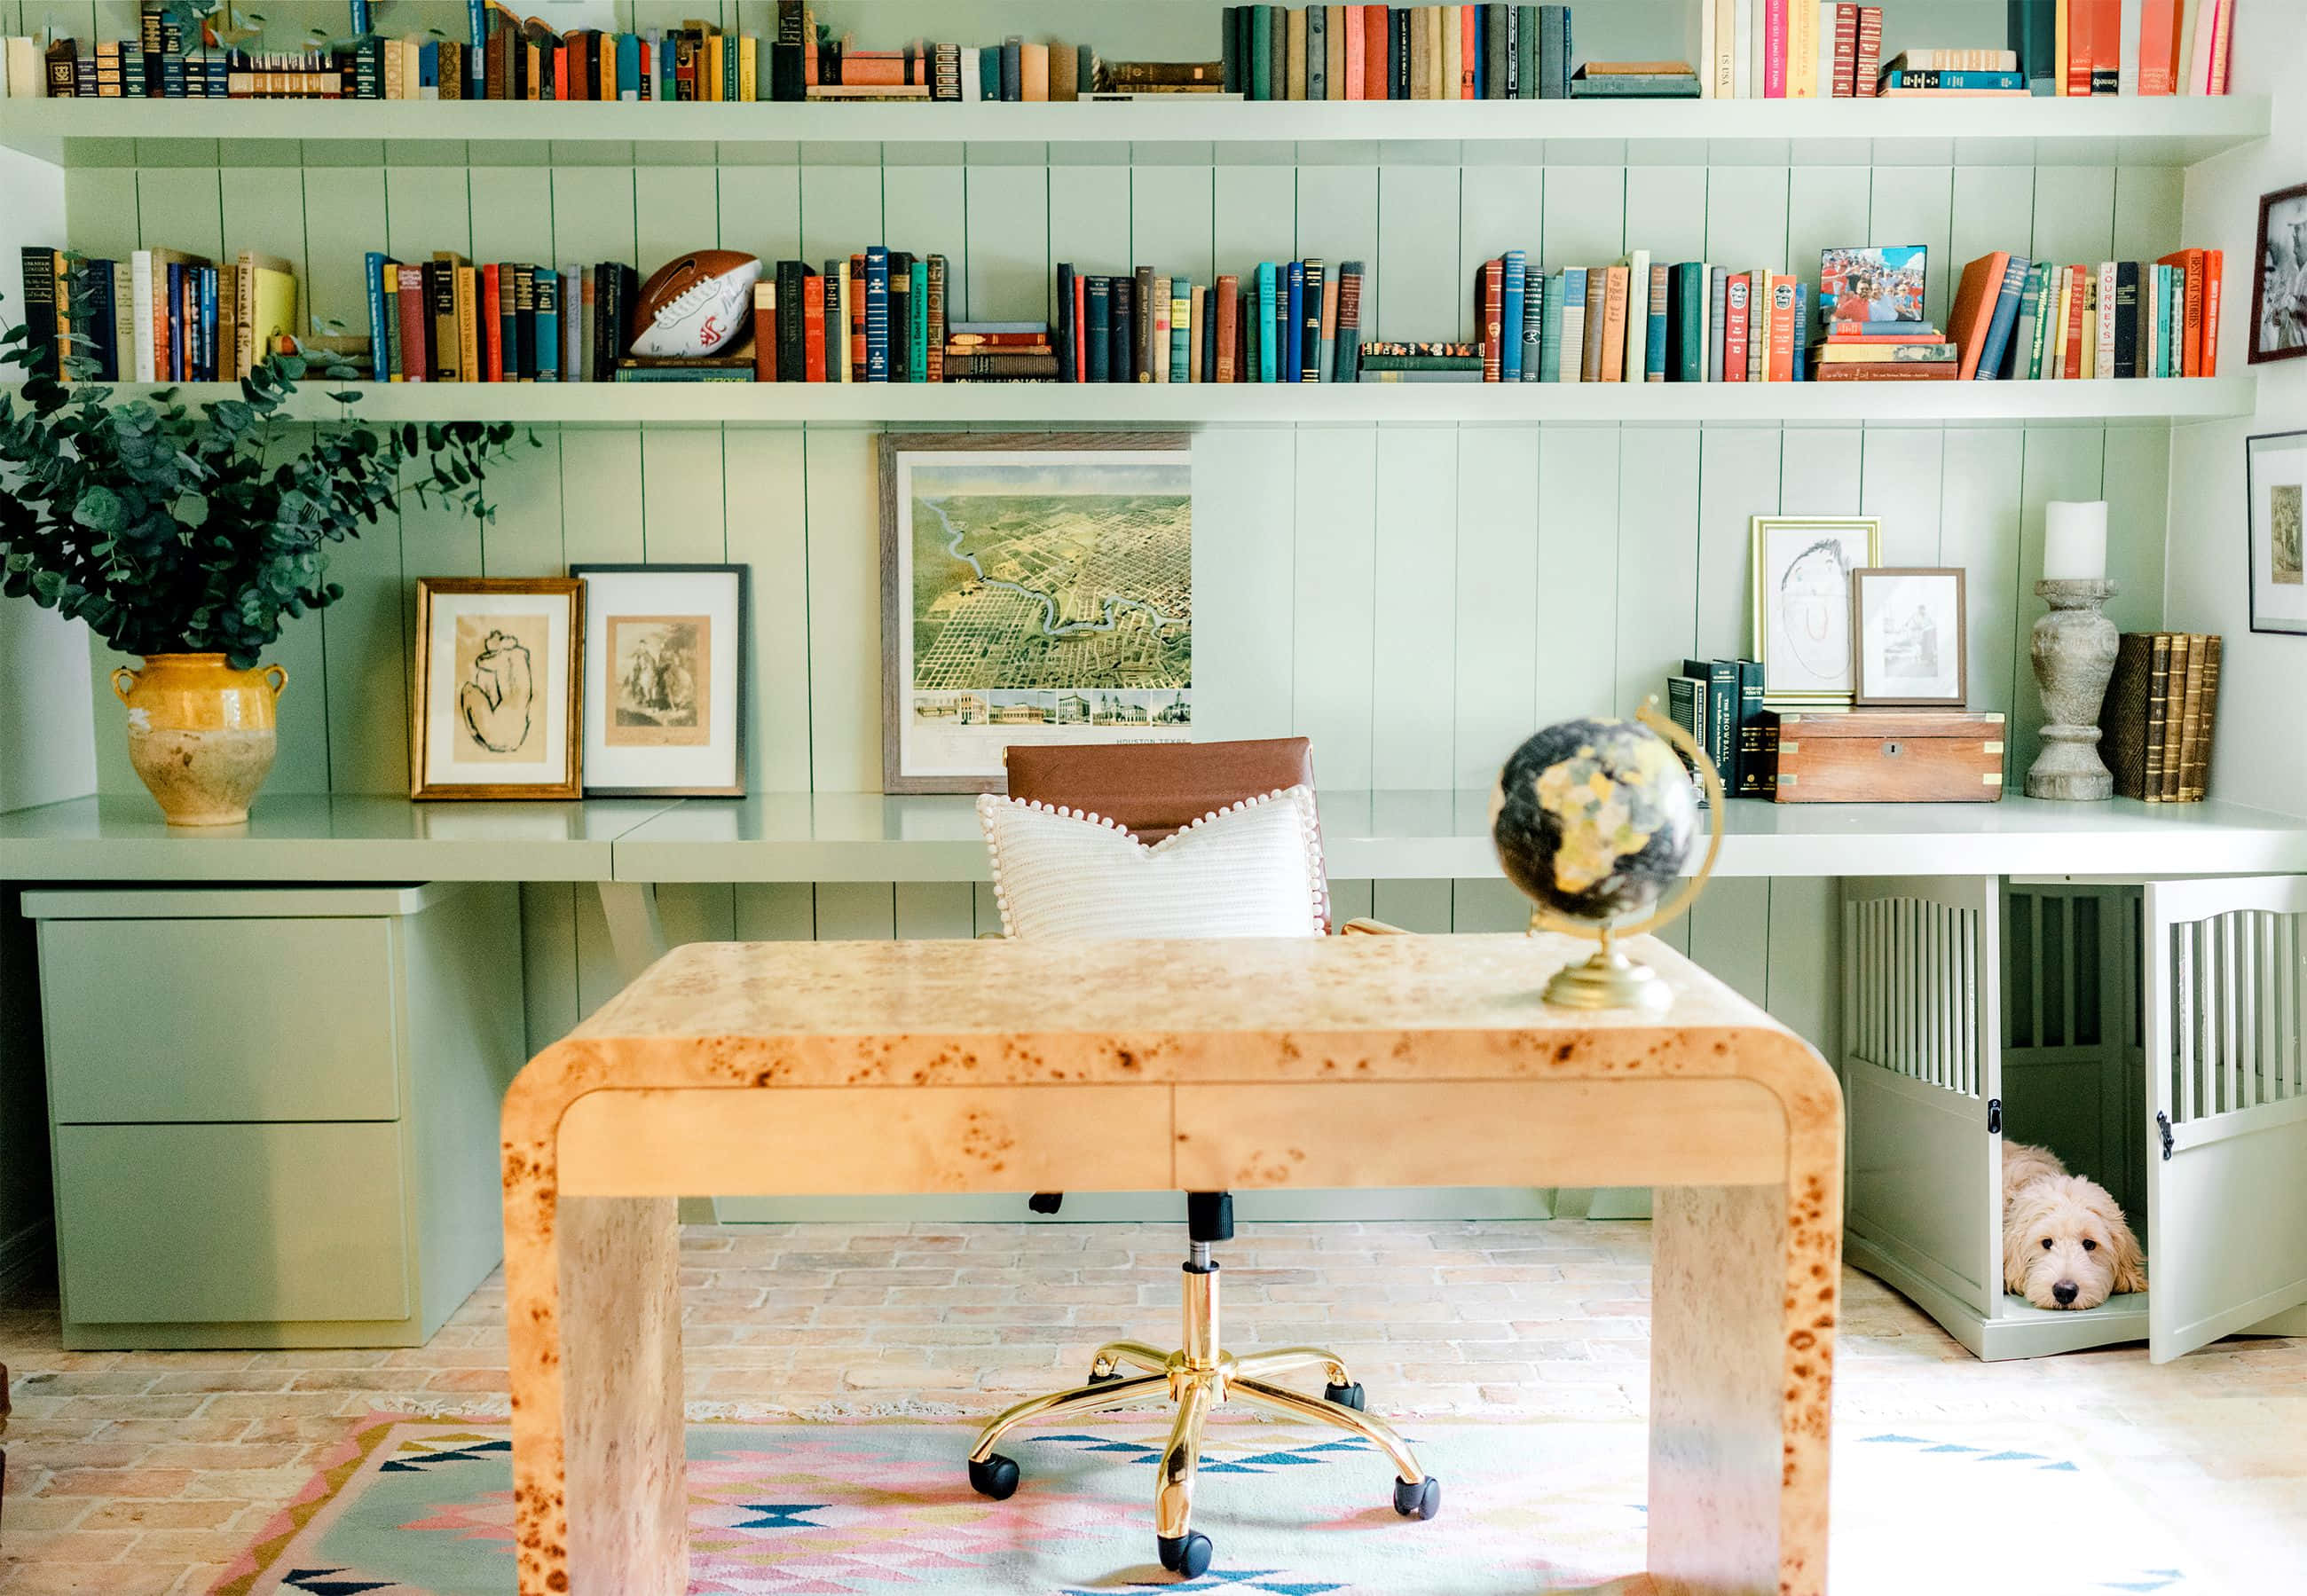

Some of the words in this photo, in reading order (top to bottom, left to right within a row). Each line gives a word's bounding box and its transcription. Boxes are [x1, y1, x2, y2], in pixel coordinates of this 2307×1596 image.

[2092, 78, 2117, 87] Kennedy
[2191, 256, 2201, 277] BEST
[788, 279, 797, 298] THE
[2190, 279, 2201, 293] CAT
[914, 283, 923, 320] Secretary
[2035, 288, 2048, 338] Wilderness
[2103, 266, 2113, 339] JOURNEYS
[2189, 295, 2200, 328] STORIES
[788, 303, 798, 342] VICTIMS
[2033, 339, 2043, 359] Wife
